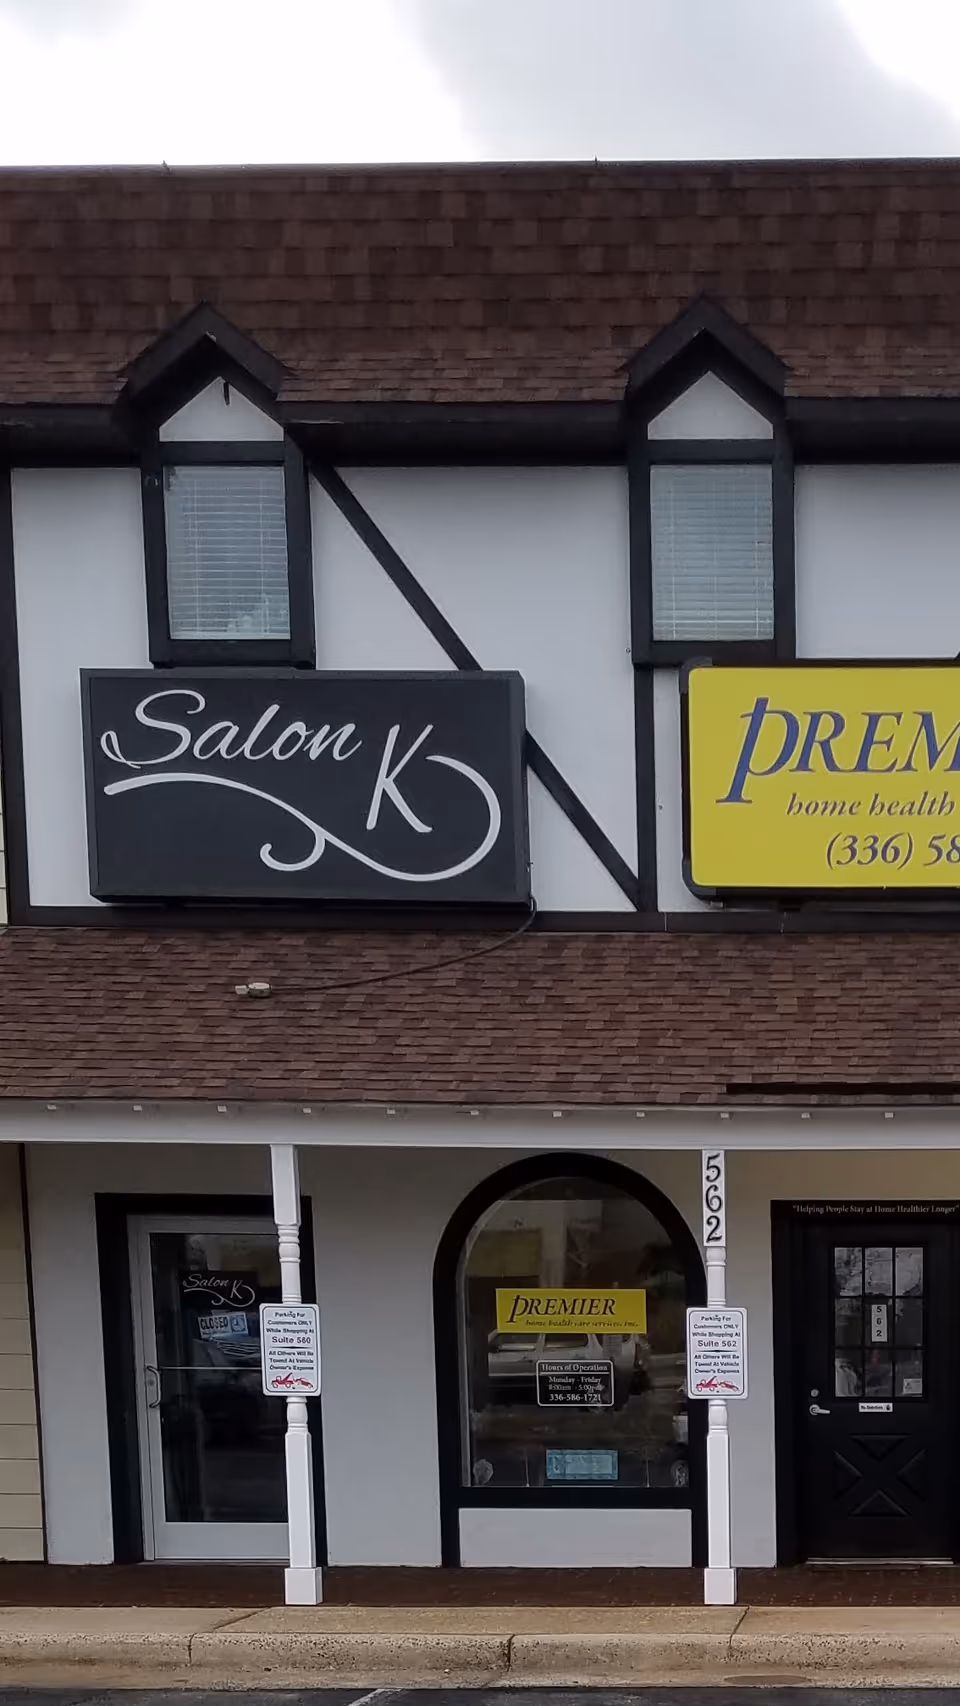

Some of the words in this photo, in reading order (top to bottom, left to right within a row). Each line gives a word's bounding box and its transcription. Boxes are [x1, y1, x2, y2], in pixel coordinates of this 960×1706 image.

[101, 689, 362, 769] Salon
[366, 724, 434, 832] K
[787, 793, 860, 817] home
[869, 790, 956, 817] health
[827, 832, 914, 870] (336)
[705, 1152, 723, 1244] 562
[826, 1205, 849, 1214] People
[850, 1205, 864, 1214] Stay
[866, 1205, 873, 1213] at
[874, 1205, 896, 1213] Home
[897, 1204, 930, 1213] Healthier
[182, 1273, 229, 1288] Salon
[230, 1280, 243, 1299] K
[505, 1294, 616, 1323] PREMIER
[200, 1316, 228, 1330] CLOSED
[526, 1319, 547, 1327] home
[548, 1319, 572, 1327] health
[541, 1363, 563, 1371] Hours
[564, 1363, 572, 1371] of
[573, 1363, 608, 1372] Operation
[547, 1376, 575, 1384] Monday
[581, 1376, 602, 1384] Friday
[549, 1393, 601, 1401] 336-586-1721
